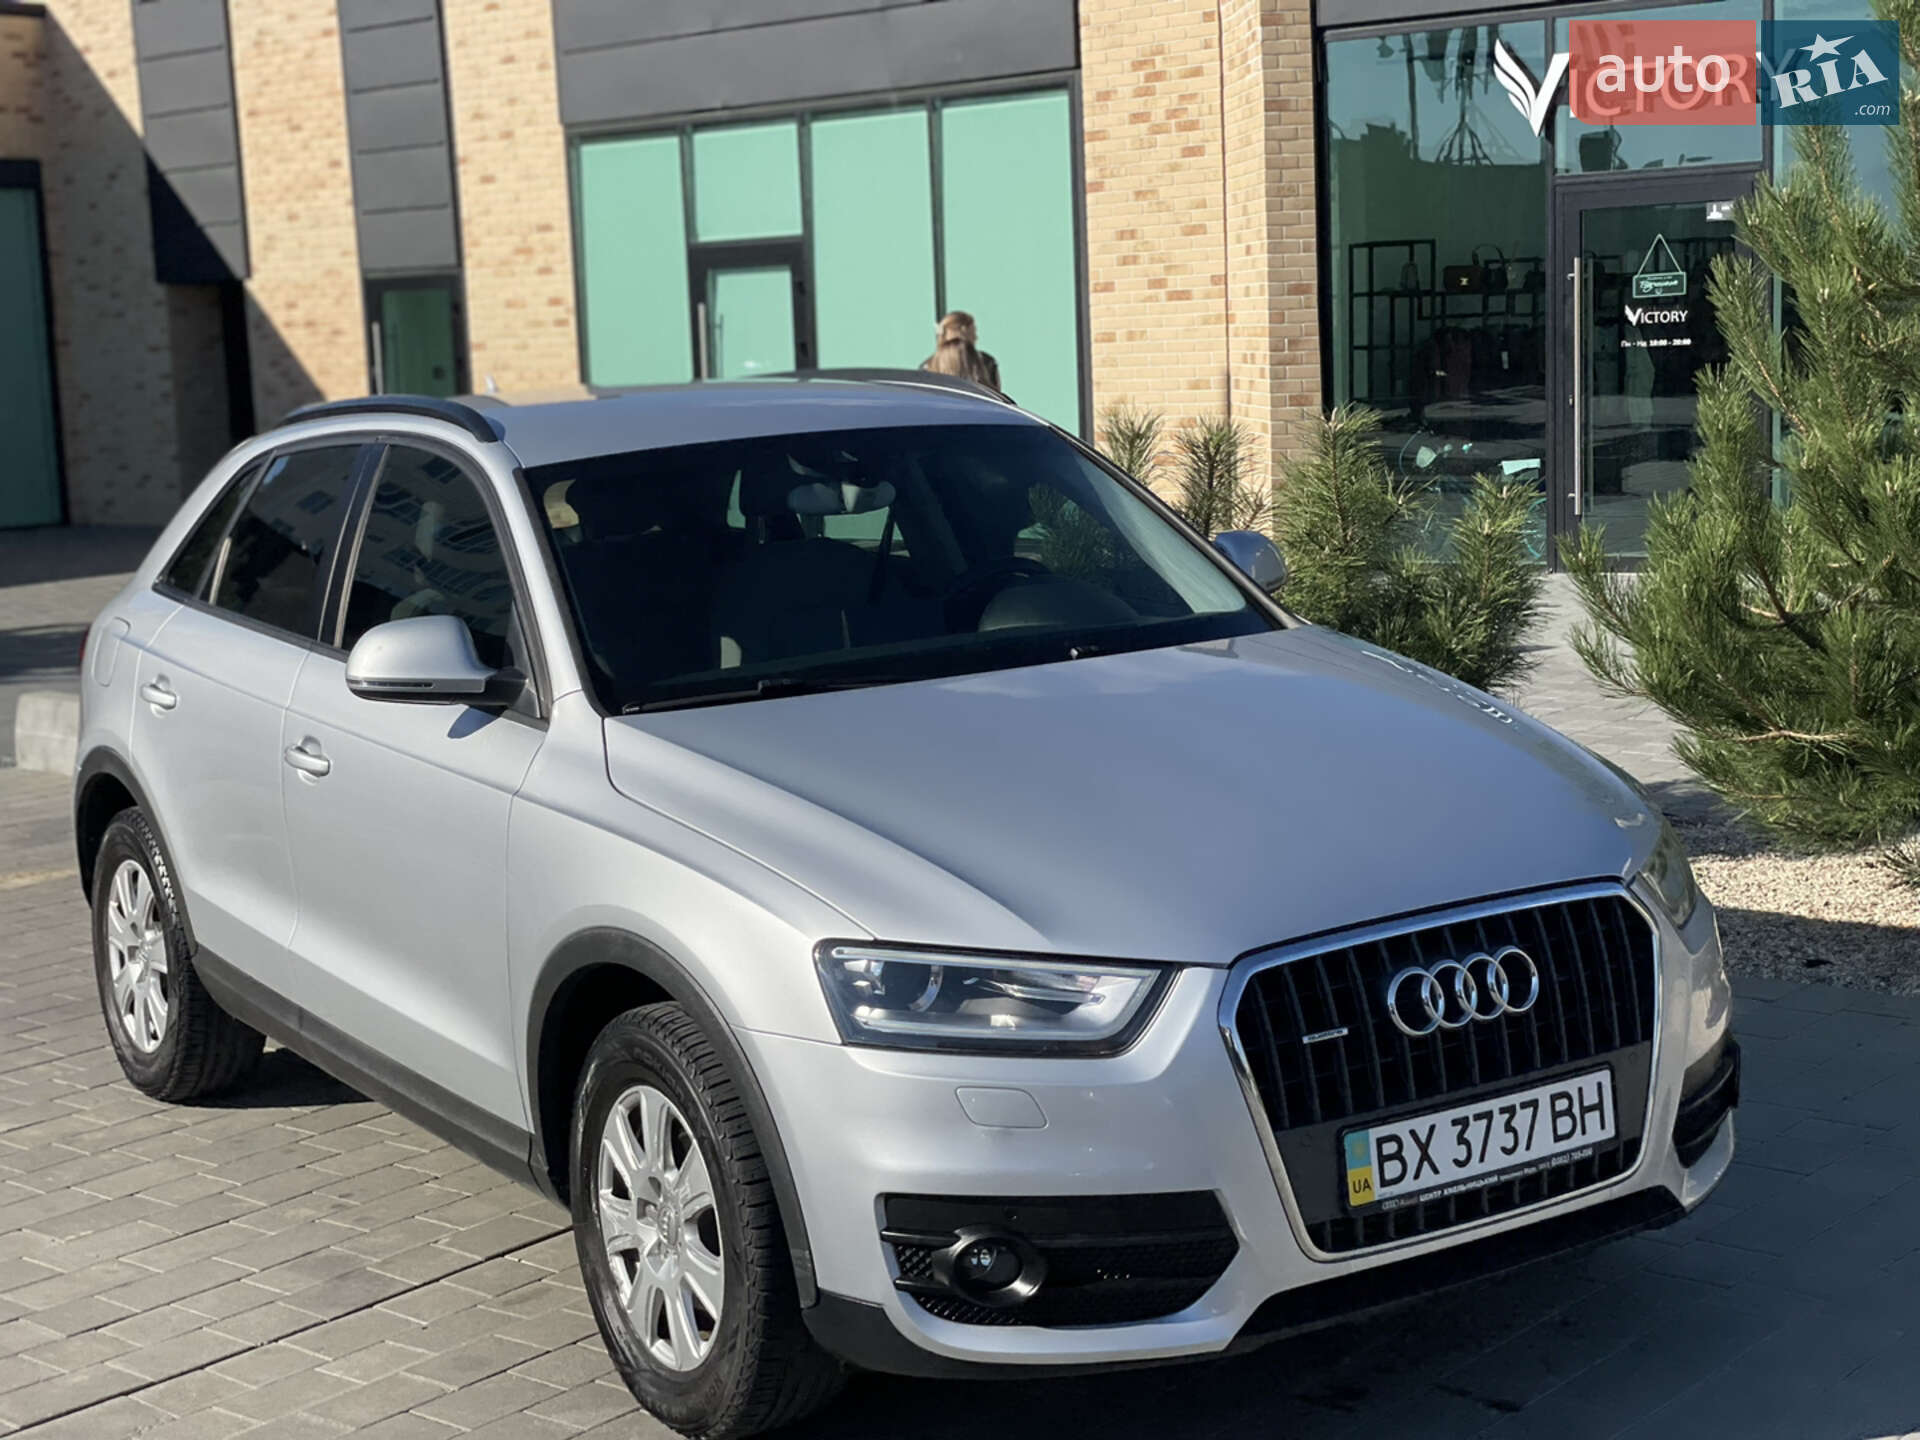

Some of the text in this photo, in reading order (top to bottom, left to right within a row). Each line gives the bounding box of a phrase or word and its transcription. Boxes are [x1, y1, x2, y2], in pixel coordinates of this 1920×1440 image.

[1624, 304, 1688, 326] VICTORY
[1375, 1081, 1606, 1188] BX 3737 BH
[1352, 1178, 1373, 1194] UA
